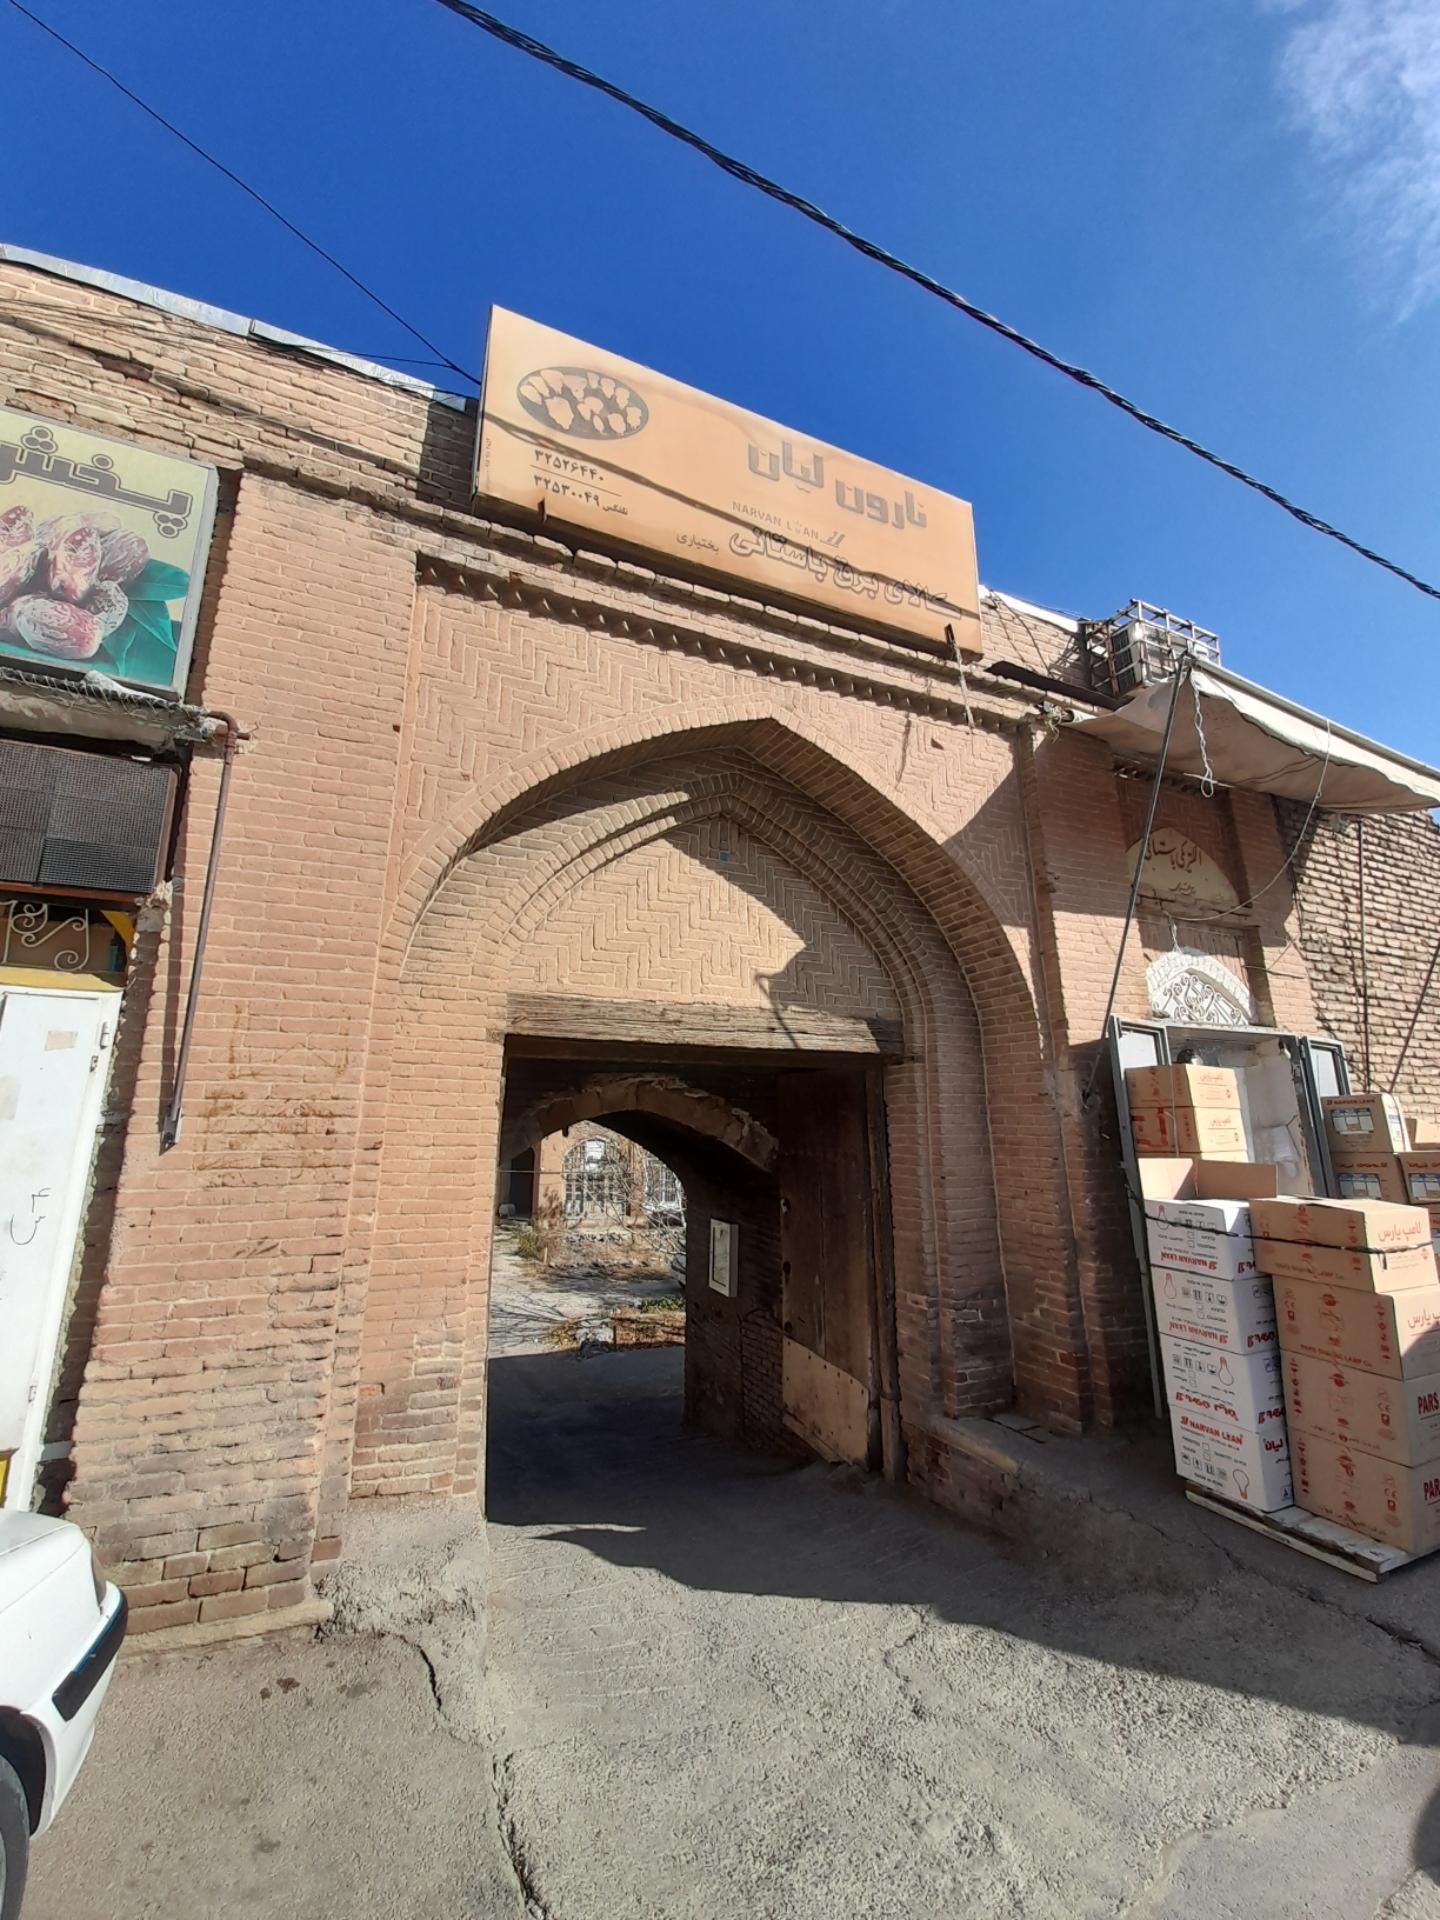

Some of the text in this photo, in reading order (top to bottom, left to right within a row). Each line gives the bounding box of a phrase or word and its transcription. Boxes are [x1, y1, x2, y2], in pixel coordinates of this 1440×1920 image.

[747, 440, 928, 529] نارون لیان
[732, 501, 820, 541] NARVAN LAN
[1417, 1391, 1440, 1415] PARS
[1423, 1478, 1440, 1501] PAR
